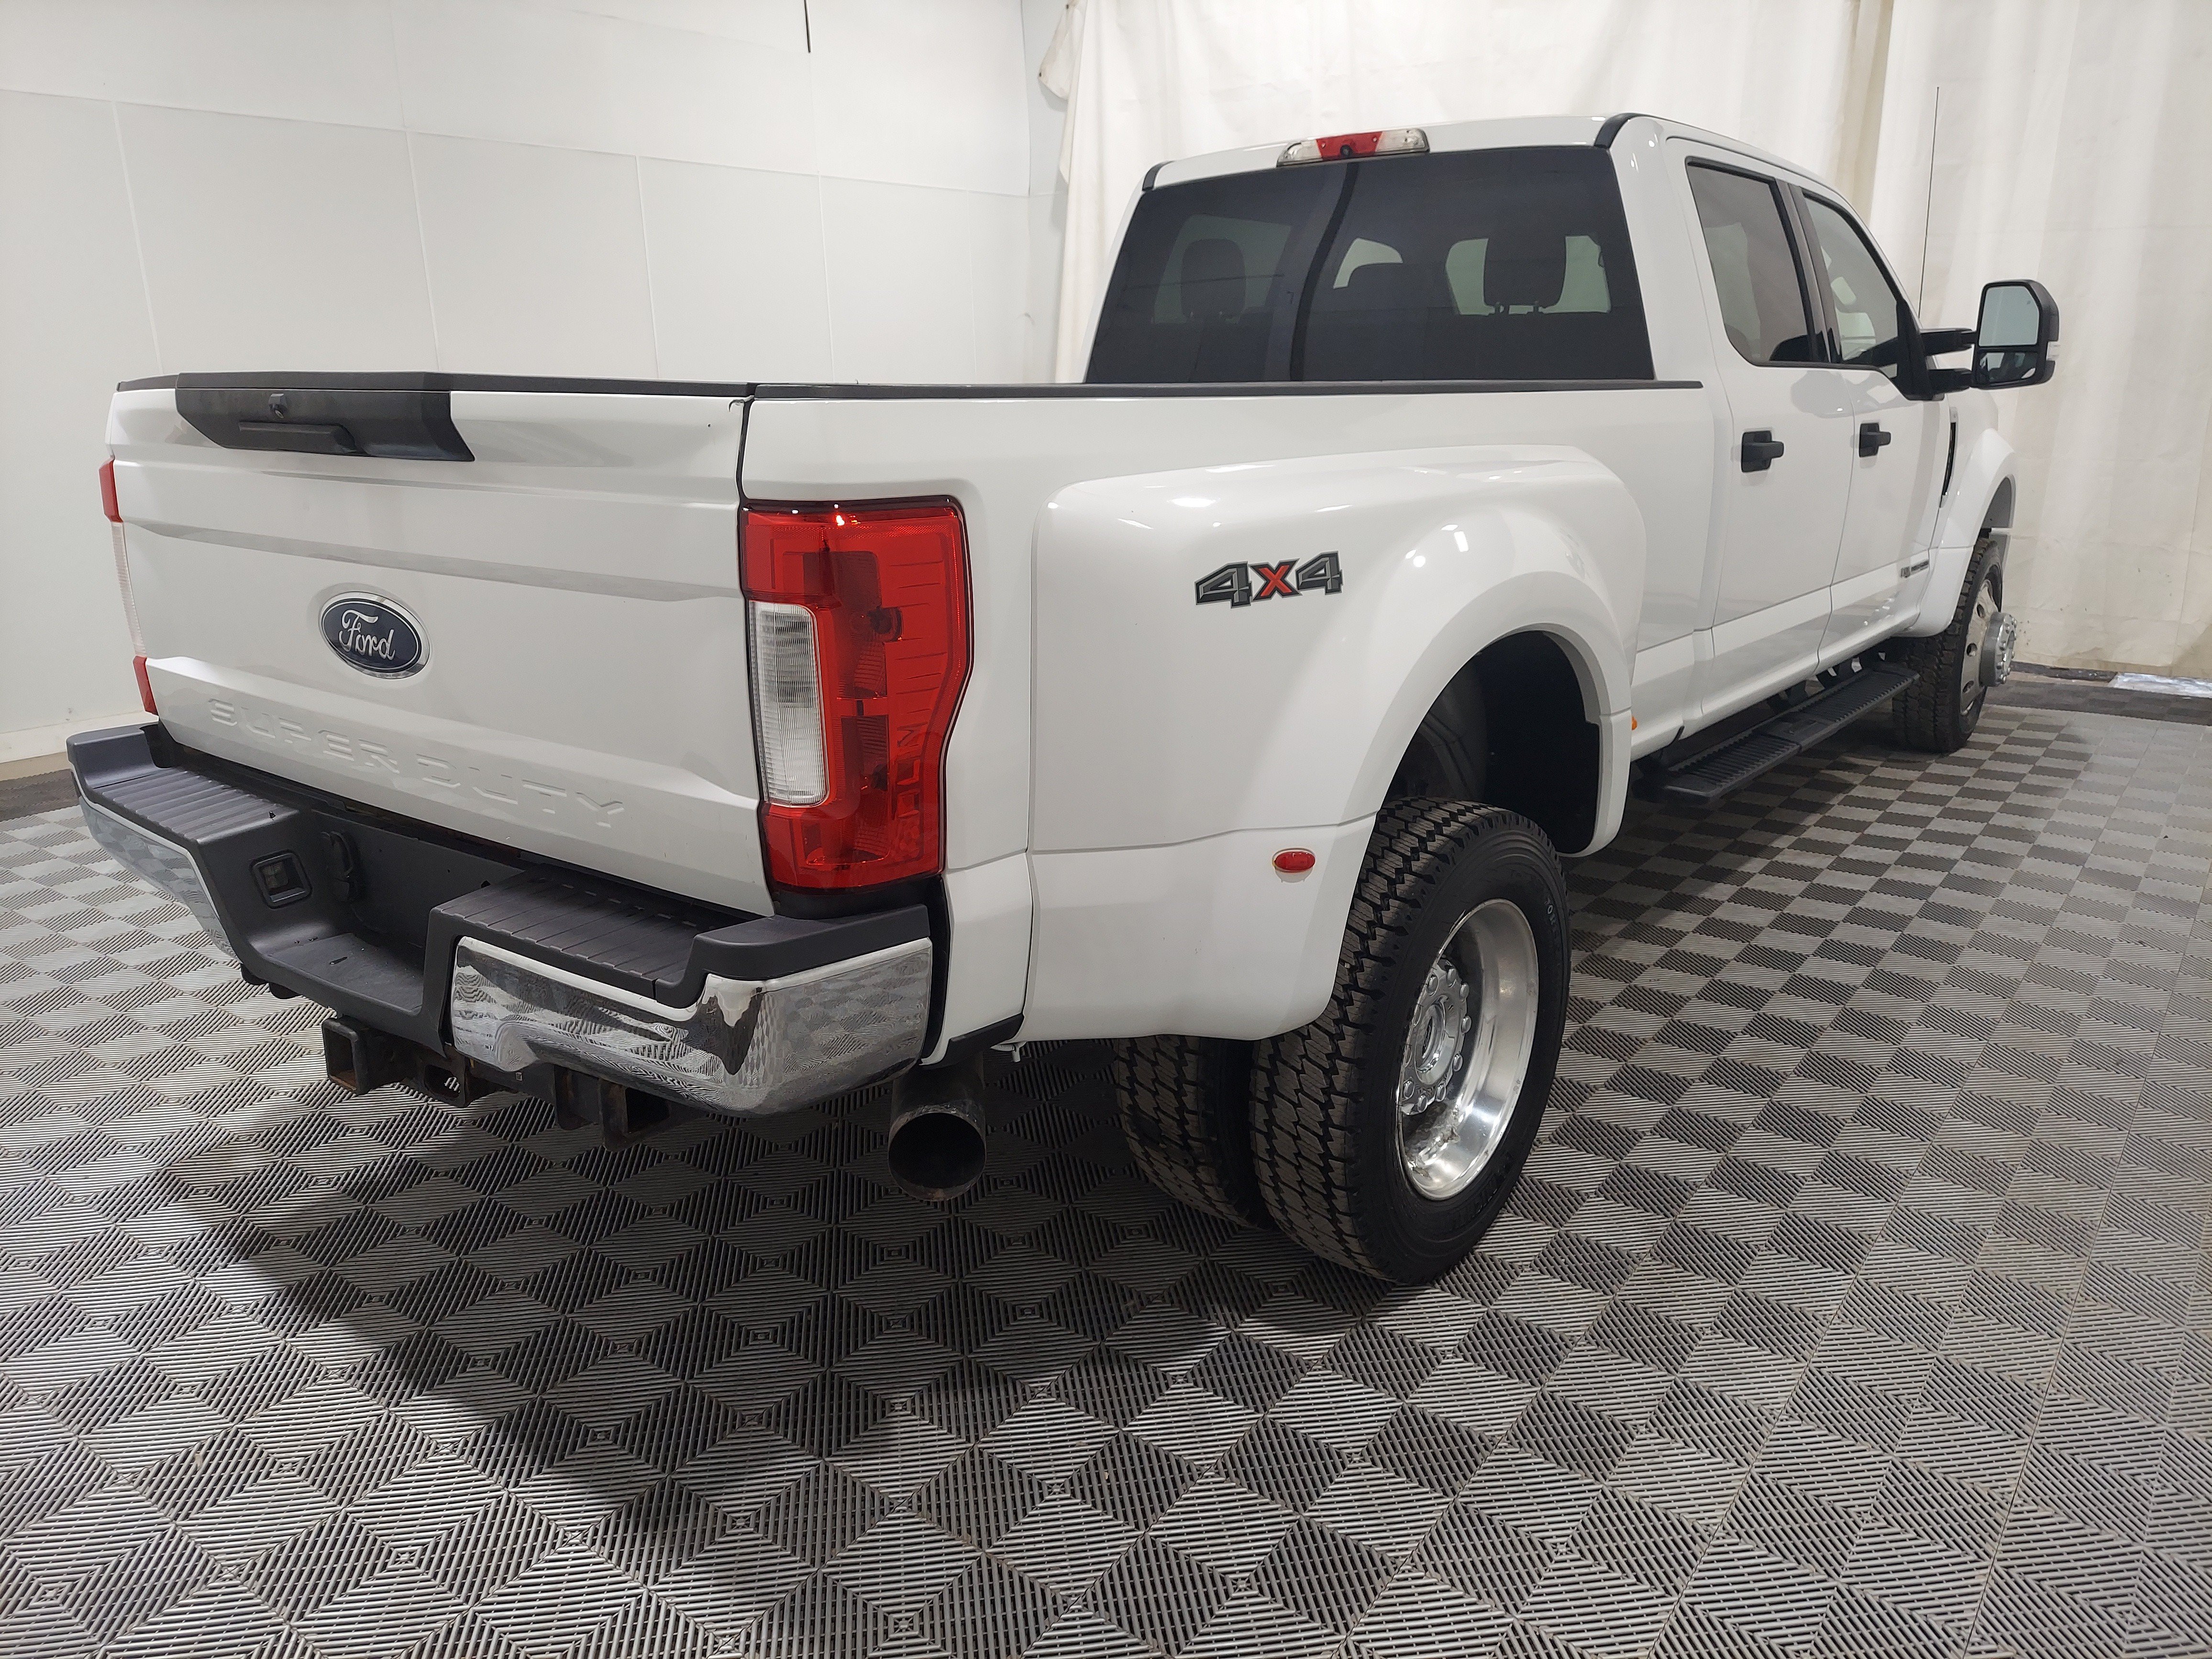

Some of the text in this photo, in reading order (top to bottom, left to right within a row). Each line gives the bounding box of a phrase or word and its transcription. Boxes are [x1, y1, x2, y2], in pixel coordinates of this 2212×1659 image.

[339, 609, 396, 660] Ford
[208, 698, 625, 828] SUPER DUTY
